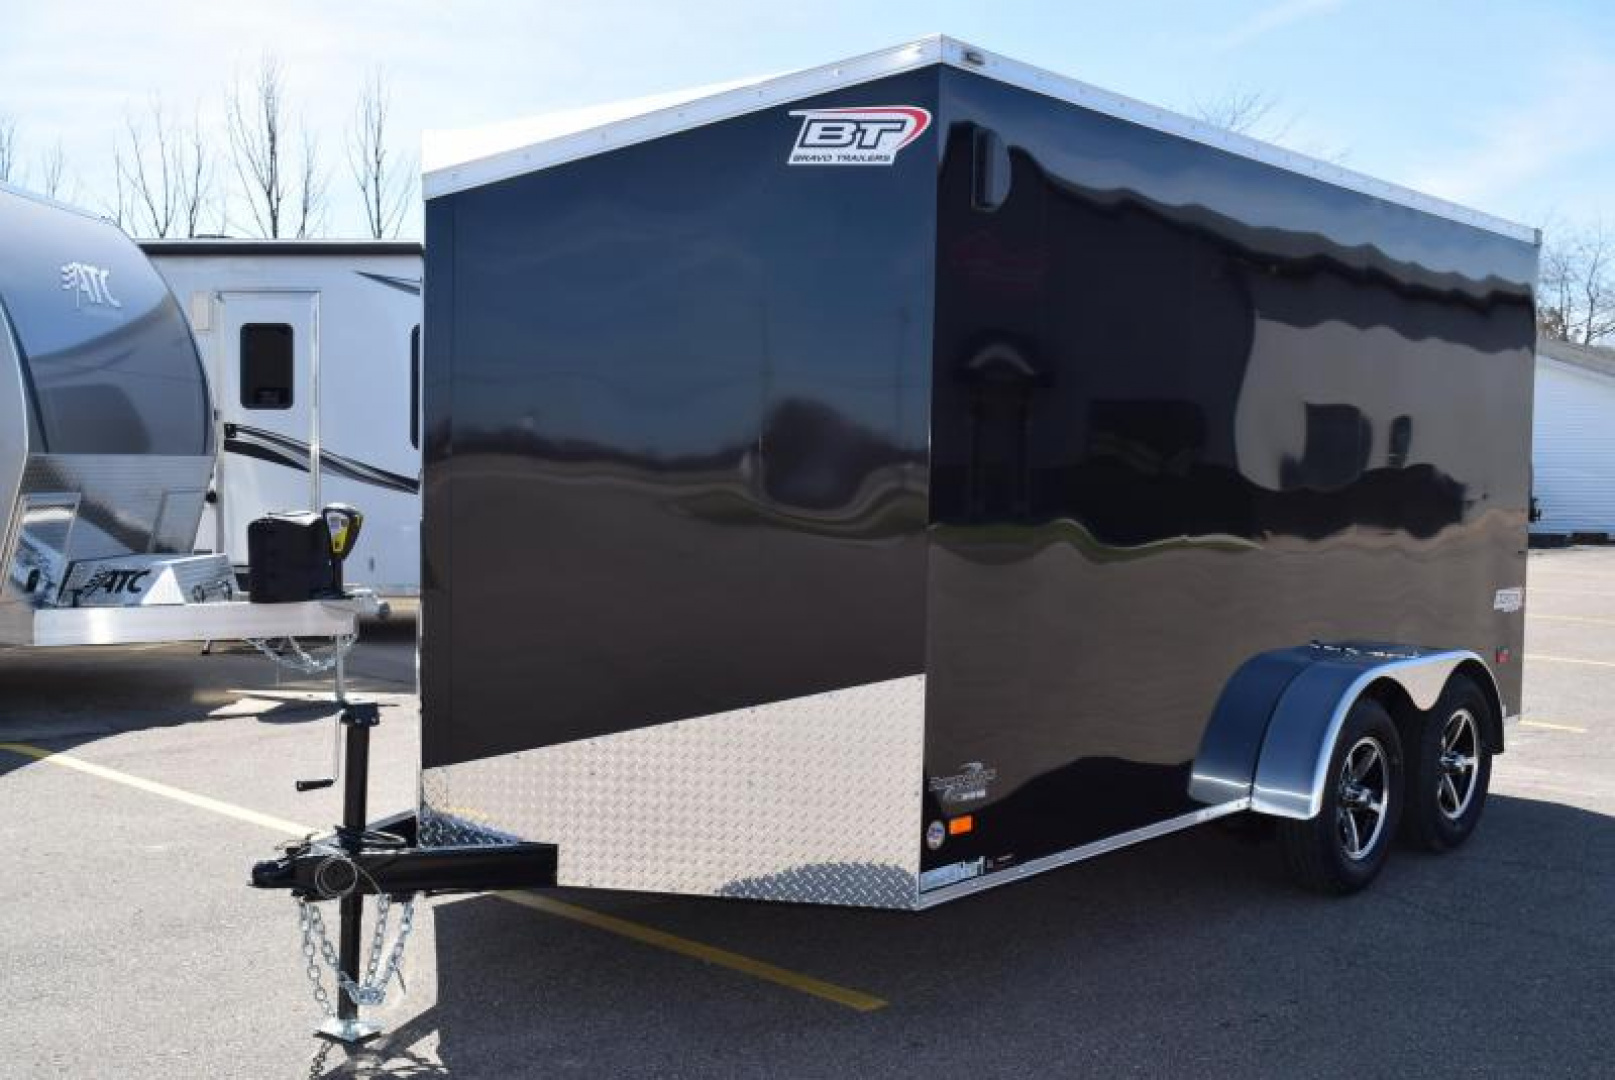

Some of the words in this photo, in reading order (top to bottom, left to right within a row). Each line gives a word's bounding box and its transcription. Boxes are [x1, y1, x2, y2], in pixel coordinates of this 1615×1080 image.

[799, 118, 908, 150] BT
[792, 153, 833, 163] BRAVO
[837, 153, 892, 163] TRAILERS
[76, 263, 121, 308] ATC
[99, 568, 152, 594] ATC
